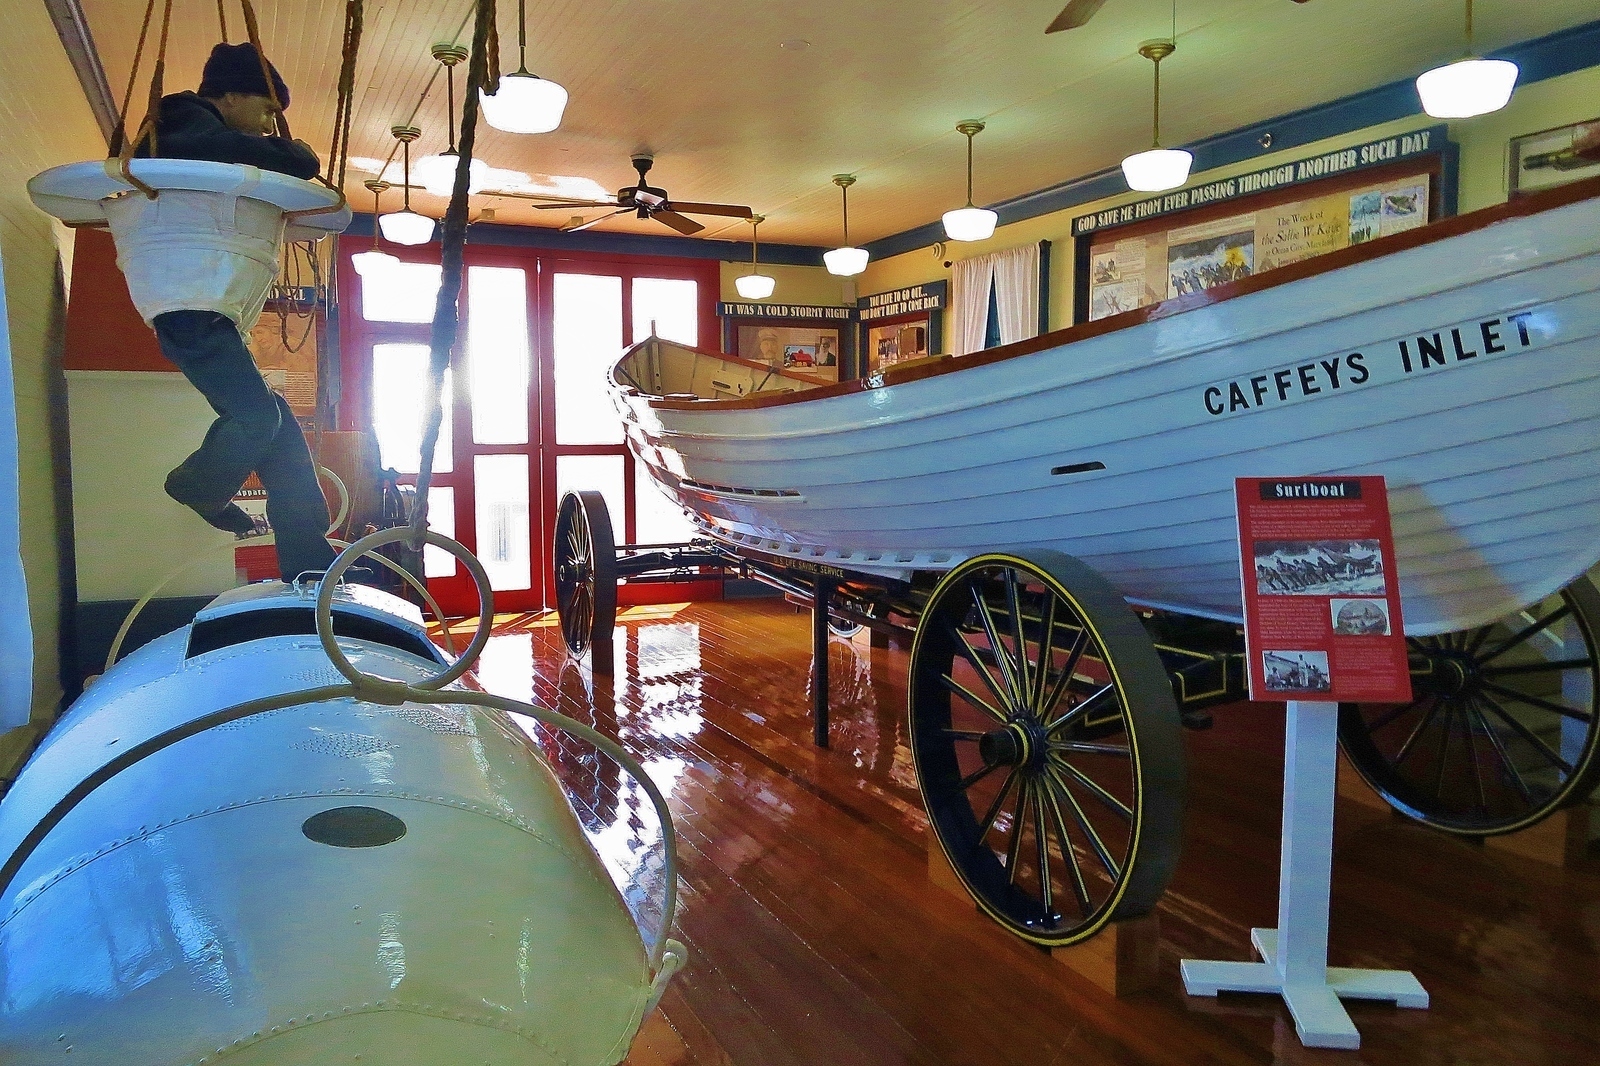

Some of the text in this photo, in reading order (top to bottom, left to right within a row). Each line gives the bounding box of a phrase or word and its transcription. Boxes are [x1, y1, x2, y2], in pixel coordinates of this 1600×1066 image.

[1078, 131, 1430, 232] GOD SAVE ME FROM EVER PASSING THROUGH ANOTHER SUCH DAY
[1277, 211, 1324, 226] The Wreck of
[1261, 233, 1274, 246] the
[860, 295, 939, 320] YOU DON'T HAVE TO COME BACK
[869, 296, 880, 308] YOU
[880, 292, 893, 306] HAVE
[894, 290, 901, 302] TO
[902, 288, 910, 301] GO
[724, 304, 850, 319] IT WAS A COLD STORMY NIGHT
[1202, 311, 1533, 416] CAFFEYS INLET
[1275, 482, 1345, 497] Surfboat
[785, 558, 796, 568] LIFE
[798, 560, 817, 572] SAVING
[820, 565, 844, 578] SERVICE
